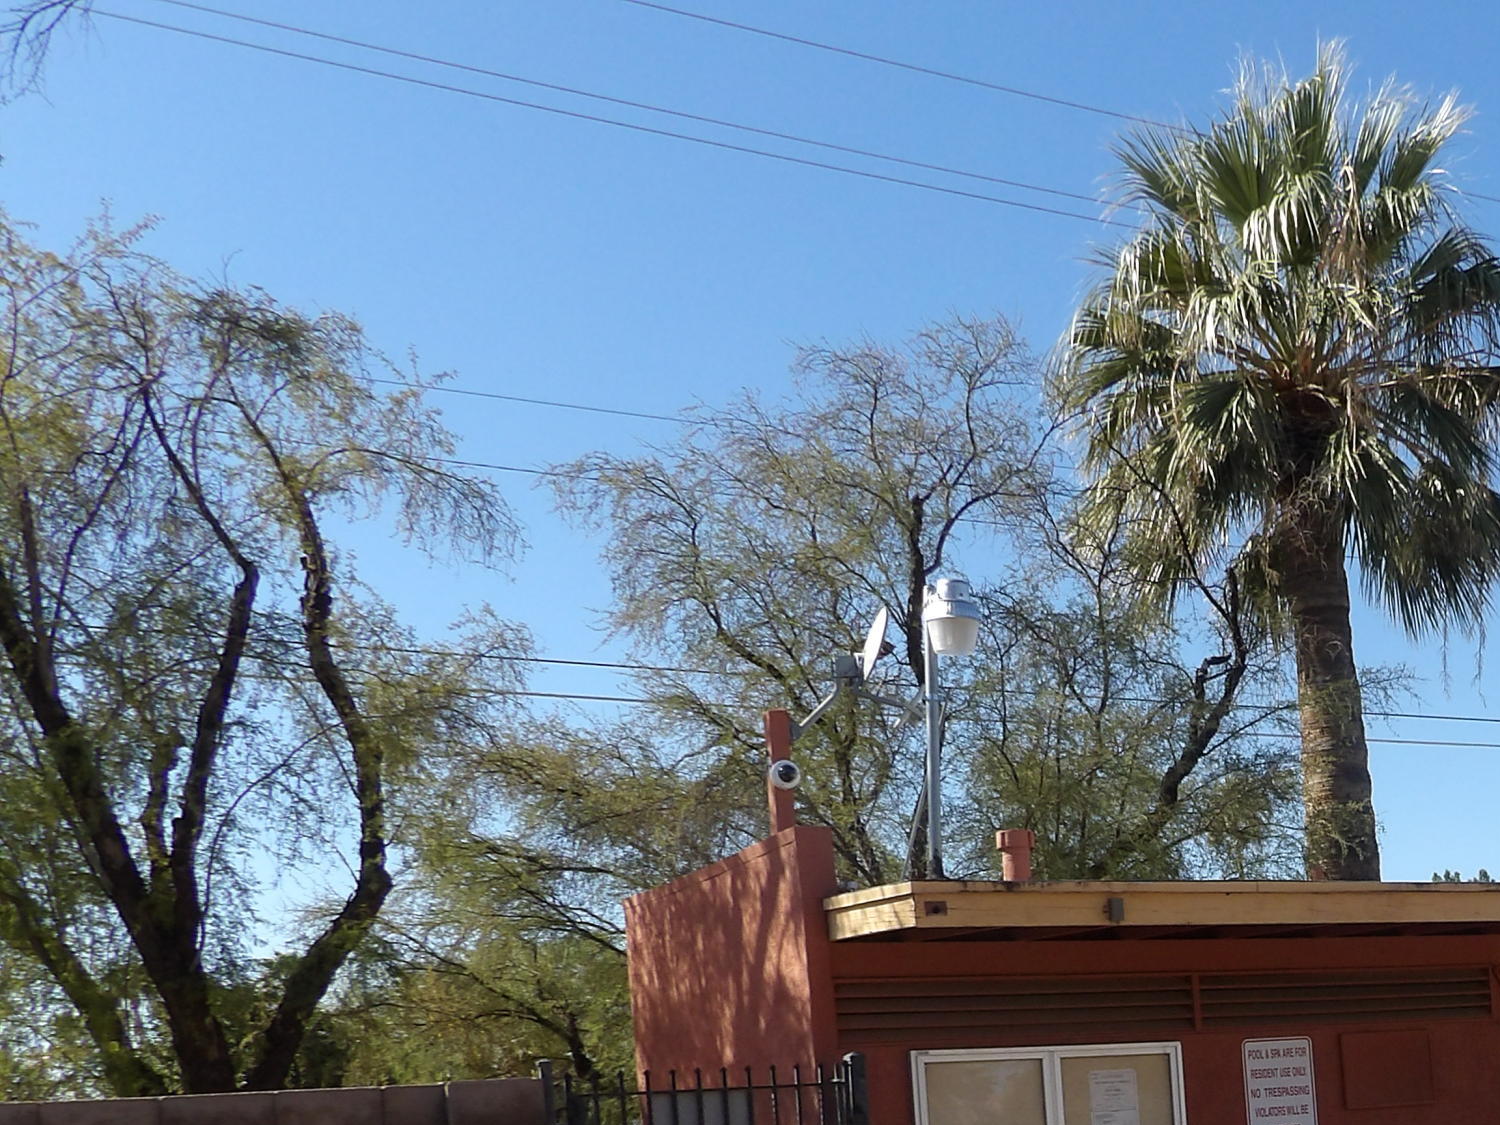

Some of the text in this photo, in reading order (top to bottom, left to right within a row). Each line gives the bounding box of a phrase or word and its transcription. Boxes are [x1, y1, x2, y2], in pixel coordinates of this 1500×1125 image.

[1248, 1049, 1264, 1060] POOL
[1282, 1047, 1294, 1058] ARE
[1295, 1046, 1307, 1057] FOR
[1250, 1066, 1306, 1080] RESIDENT USE ONLY
[1250, 1085, 1310, 1099] NO TRESPASSING
[1255, 1104, 1309, 1118] VIOLATORS WILL BE
